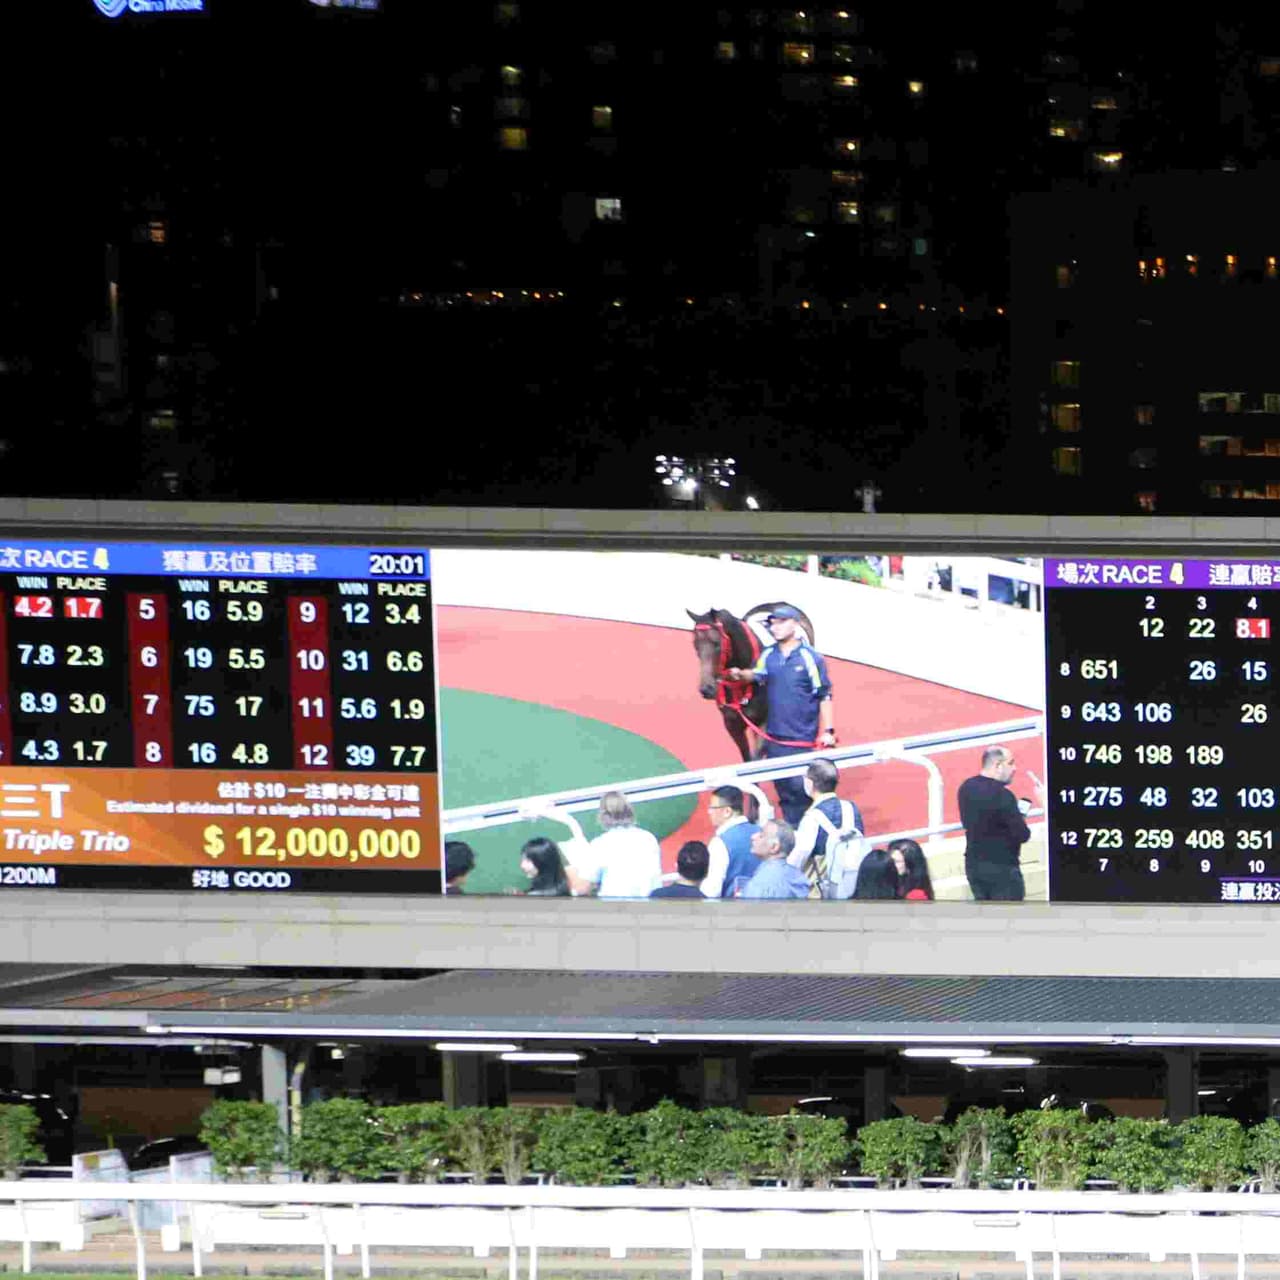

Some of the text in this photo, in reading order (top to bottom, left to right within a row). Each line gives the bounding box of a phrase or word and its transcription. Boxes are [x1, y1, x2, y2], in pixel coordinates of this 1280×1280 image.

[24, 549, 89, 568] RACE
[93, 548, 109, 569] 4
[369, 555, 423, 574] 20:01
[1057, 563, 1099, 584] 場次
[1103, 565, 1162, 583] RACE
[1170, 563, 1184, 584] 4
[17, 577, 426, 596] WIN PLACE WIN PLACE WIN PLACE
[15, 597, 421, 624] 4.2 1.7 5 16 5.9 9 12 3.4
[1140, 618, 1164, 637] 12
[1189, 619, 1215, 637] 22
[1237, 619, 1266, 638] 8.1
[18, 645, 423, 671] 7.8 2.3 6 19 5.5 10 31 6.6
[21, 692, 424, 719] 8.9 3.0 7 75 17 11 5.6 1.9
[22, 740, 425, 766] 4.3 1.7 8 16 4.8 12 39 7.7
[1060, 790, 1074, 802] 11
[1084, 787, 1122, 806] 275
[1140, 787, 1167, 806] 48
[1192, 788, 1217, 807] 32
[1237, 788, 1274, 807] 103
[235, 803, 256, 815] for
[258, 806, 267, 815] a
[269, 803, 310, 818] single
[312, 803, 337, 816] $10
[338, 805, 392, 819] winning
[4, 828, 130, 853] Triple Trio
[204, 824, 421, 861] $ 12,000,000
[234, 871, 291, 888] GOOD
